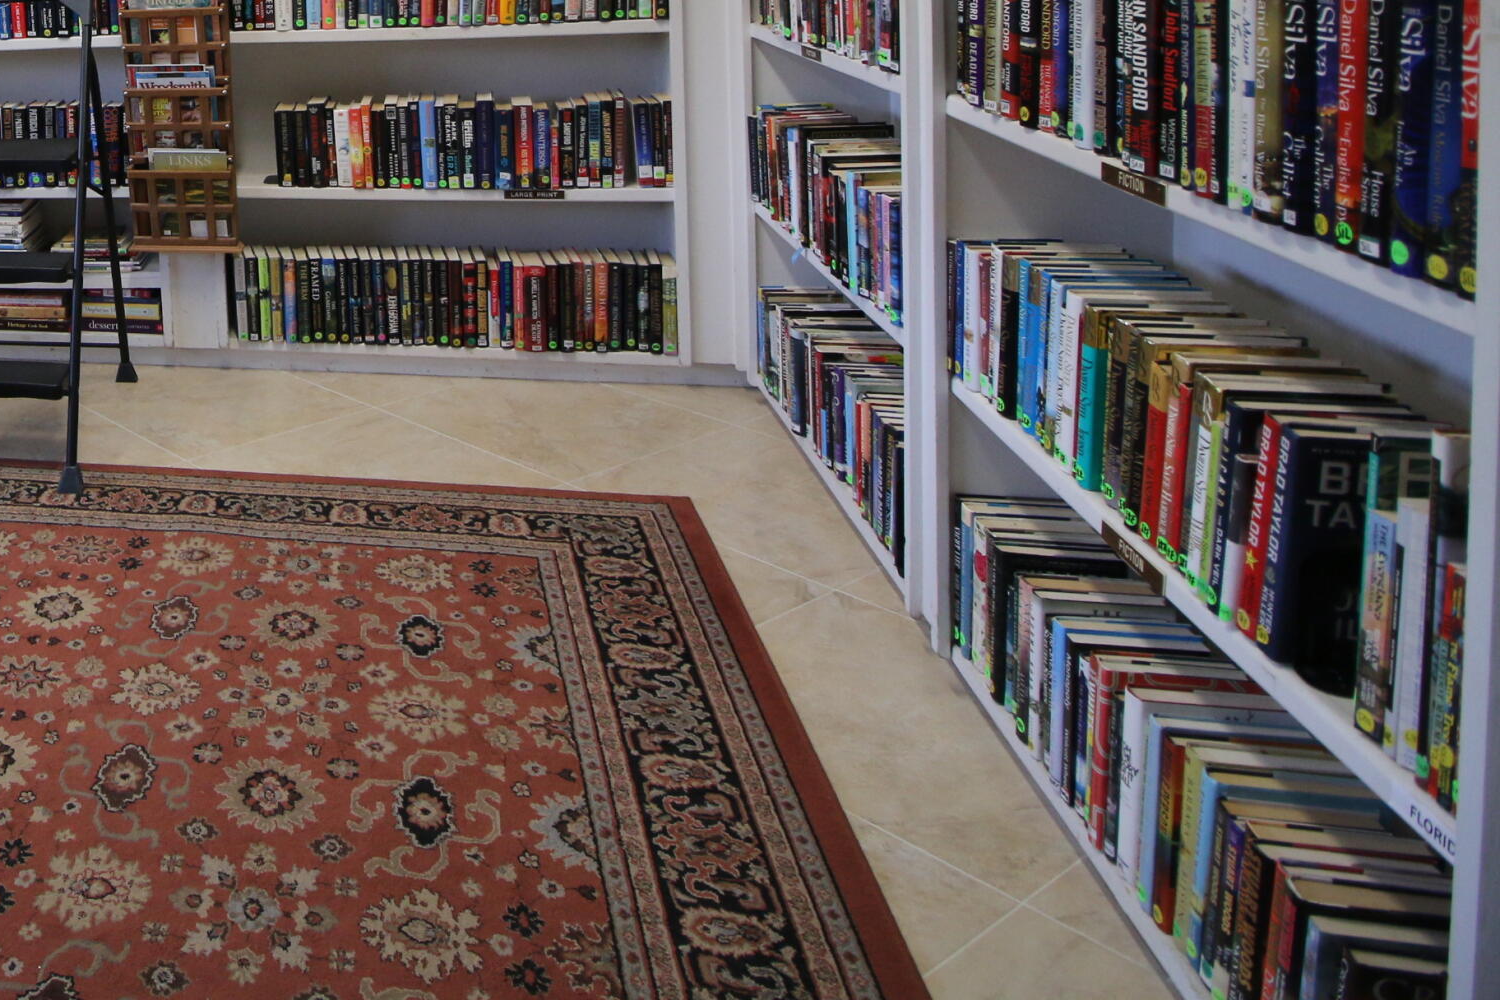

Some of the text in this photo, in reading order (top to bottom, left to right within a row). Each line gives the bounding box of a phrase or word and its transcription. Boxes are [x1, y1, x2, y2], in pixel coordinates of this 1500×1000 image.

[987, 37, 996, 60] EASY
[1133, 22, 1148, 111] SANDFORD
[1163, 11, 1178, 111] John Sandford
[1284, 3, 1307, 80] Silva
[1316, 5, 1337, 77] Silva
[1399, 16, 1425, 92] Silva
[1435, 4, 1452, 125] Daniel Silva
[969, 42, 978, 94] DEADLINE
[1256, 46, 1269, 89] Silva
[1338, 64, 1355, 112] Silva
[1366, 66, 1383, 116] Silva
[168, 154, 213, 168] LINKS
[1167, 119, 1176, 162] WICKED
[1294, 136, 1305, 159] The
[1338, 137, 1351, 193] English
[1118, 173, 1145, 193] FICTION
[1323, 164, 1333, 190] The
[1370, 171, 1384, 217] House
[1337, 197, 1349, 224] Spy
[311, 261, 319, 300] FRAMED
[1246, 424, 1272, 549] BRAD TAYLOR
[1267, 435, 1290, 563] BRAD TAYLOR
[1118, 538, 1145, 574] FICTION
[1211, 527, 1223, 586] DARK VEIL
[1409, 805, 1456, 857] FLORID
[1222, 844, 1236, 934] STUART WOODS
[1240, 853, 1261, 990] STUART WOODS
